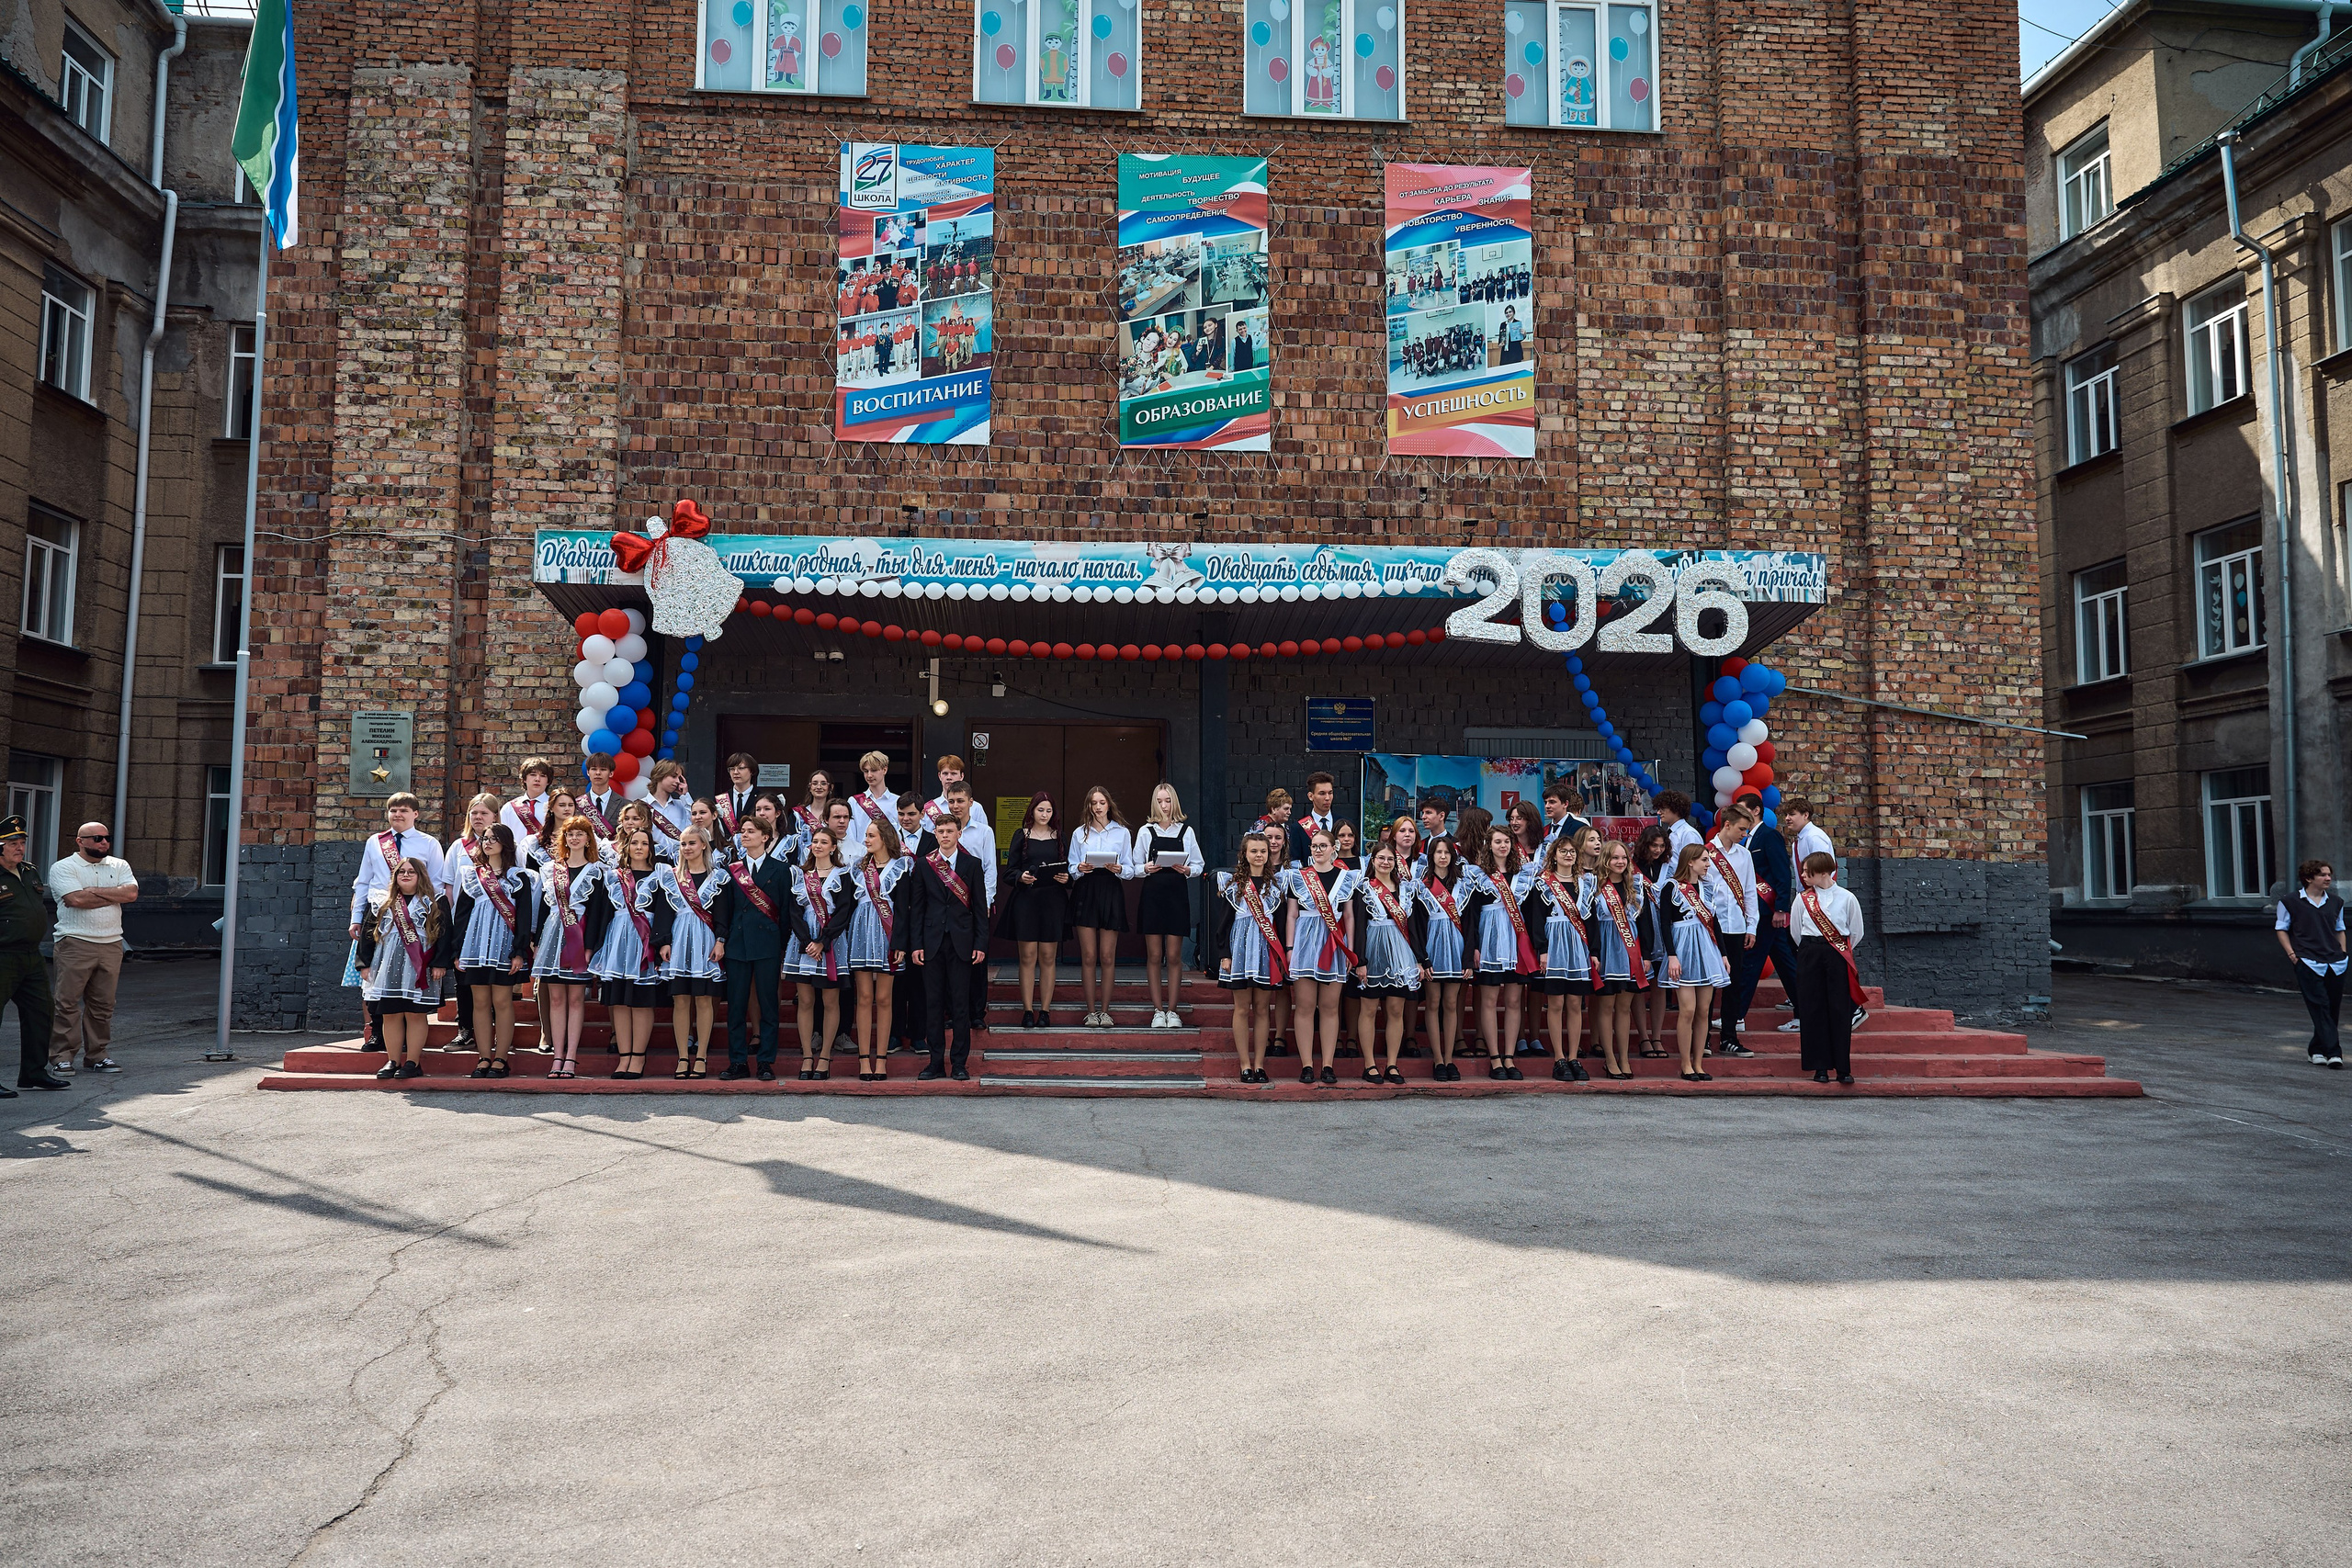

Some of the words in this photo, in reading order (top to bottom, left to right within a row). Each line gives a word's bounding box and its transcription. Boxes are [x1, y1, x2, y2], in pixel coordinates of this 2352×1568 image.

[906, 154, 945, 165] ТРУДОЛЮБИЕ
[935, 158, 976, 169] ХАРАКТЕР
[856, 155, 893, 186] 27
[906, 172, 947, 184] ЦЕННОСТИ
[1138, 169, 1182, 180] МОТИВАЦИЯ
[934, 174, 988, 187] АКТИВНОСТЬ
[1182, 173, 1221, 184] БУДУЩЕЕ
[904, 189, 952, 201] ПРОСТРАНСТВО
[1409, 187, 1442, 197] ЗАМЫСЛА
[1454, 178, 1494, 191] РЕЗУЛЬТАТА
[854, 194, 892, 203] ШКОЛА
[920, 190, 978, 205] ВОЗМОЖНОСТЕЙ
[1141, 190, 1195, 203] ДЕЯТЕЛЬНОСТЬ
[1187, 193, 1240, 205] ТВОРЧЕСТВО
[1434, 194, 1472, 206] КАРЬЕРА
[1478, 195, 1513, 206] ЗНАНИЯ
[1146, 209, 1228, 225] САМООПРЕДЕЛЕНИЕ
[1401, 212, 1464, 228] НОВАТОРСТВО
[1454, 218, 1516, 233] УВЕРЕННОСТЬ
[853, 379, 983, 415] ВОСПИТАНИЕ
[1402, 386, 1528, 421] УСПЕШНОСТЬ
[1135, 389, 1263, 425] ОБРАЗОВАНИЕ
[542, 539, 618, 574] Двадца
[729, 551, 792, 573] школа
[796, 545, 867, 578] родная,
[875, 548, 908, 573] ты
[911, 547, 945, 574] для
[950, 556, 998, 576] меня
[1014, 559, 1078, 578] начало
[1082, 559, 1143, 580] начал.
[1207, 553, 1296, 585] Двадцать
[1385, 561, 1442, 581] школа
[1444, 547, 1748, 658] 2026
[1757, 882, 1772, 895] 026
[1306, 871, 1329, 911] Выпускница
[1322, 913, 1338, 931] 2026
[1604, 884, 1626, 928] Выпускница
[1621, 928, 1635, 948] 2026
[1261, 921, 1277, 942] 2026
[1828, 934, 1849, 952] 2026
